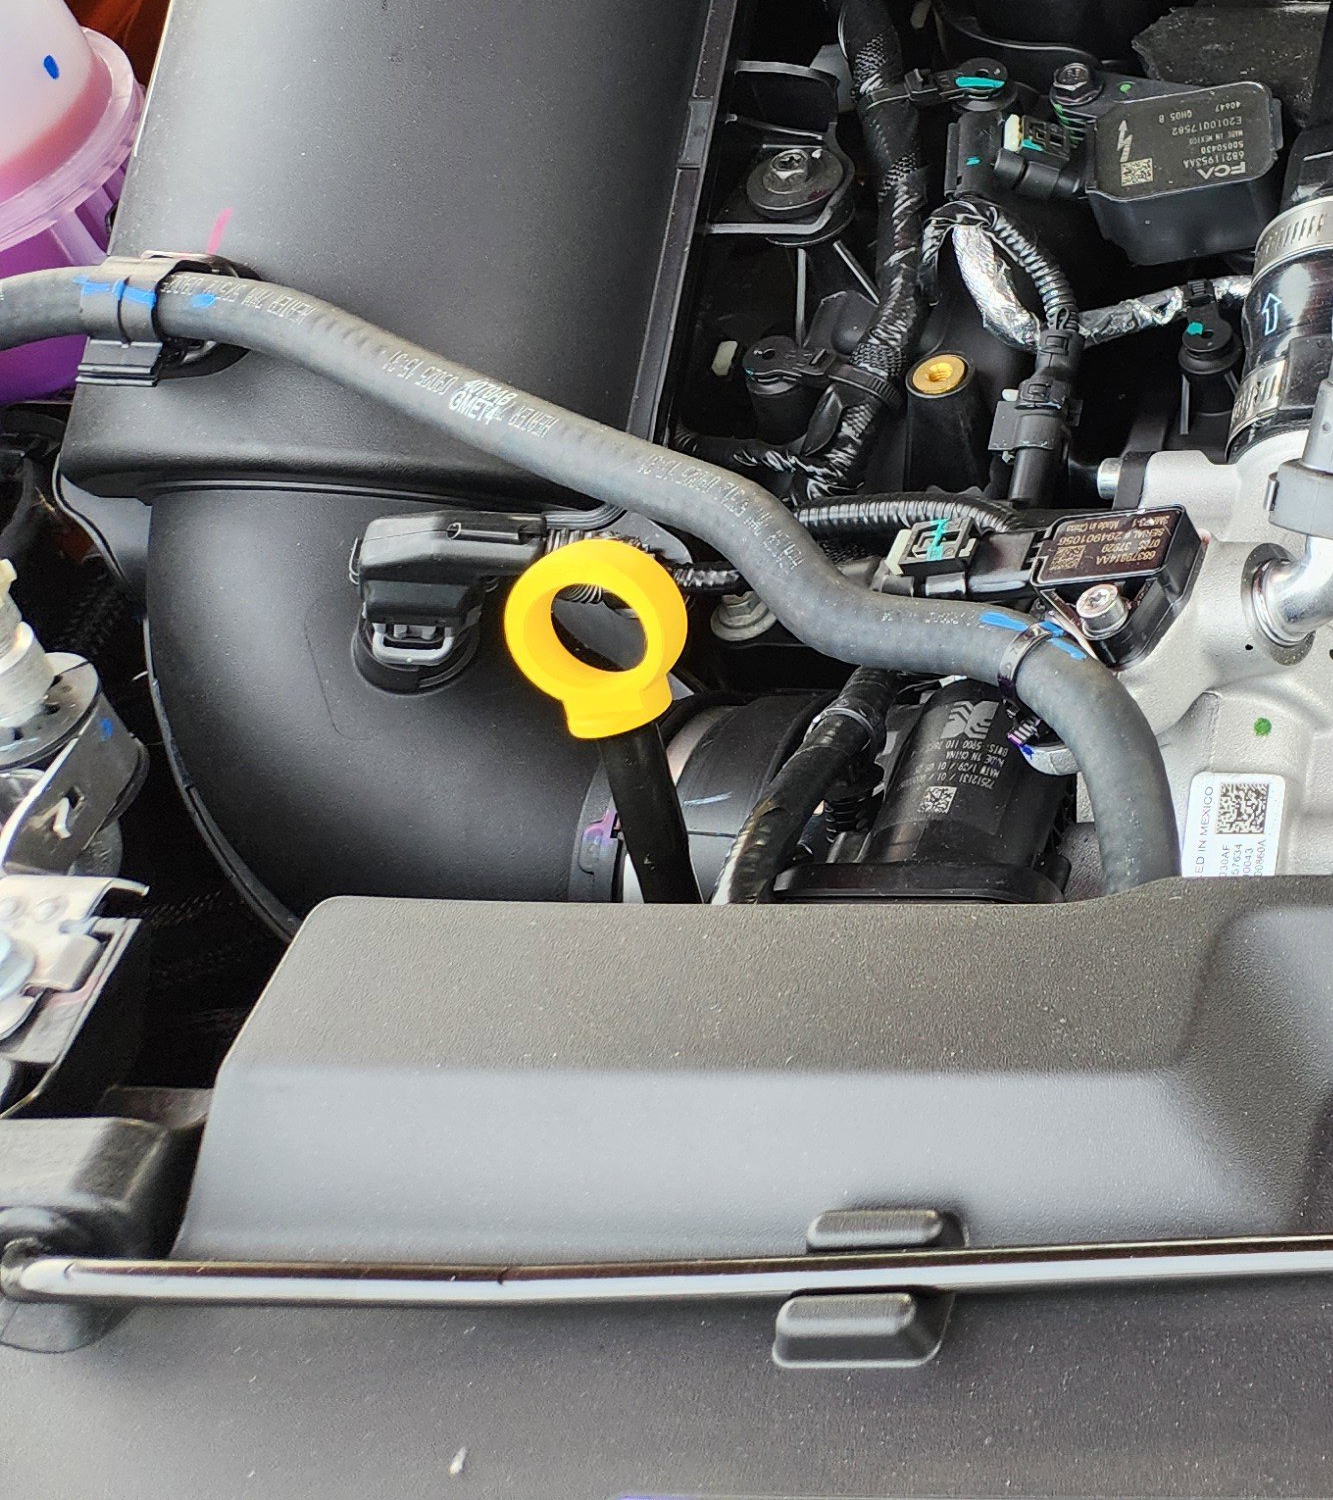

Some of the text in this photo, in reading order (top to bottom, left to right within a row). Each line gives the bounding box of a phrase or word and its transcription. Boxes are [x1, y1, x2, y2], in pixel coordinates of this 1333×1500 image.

[1196, 161, 1246, 180] FCA
[1200, 786, 1213, 835] MEXICO
[1198, 840, 1206, 851] IN
